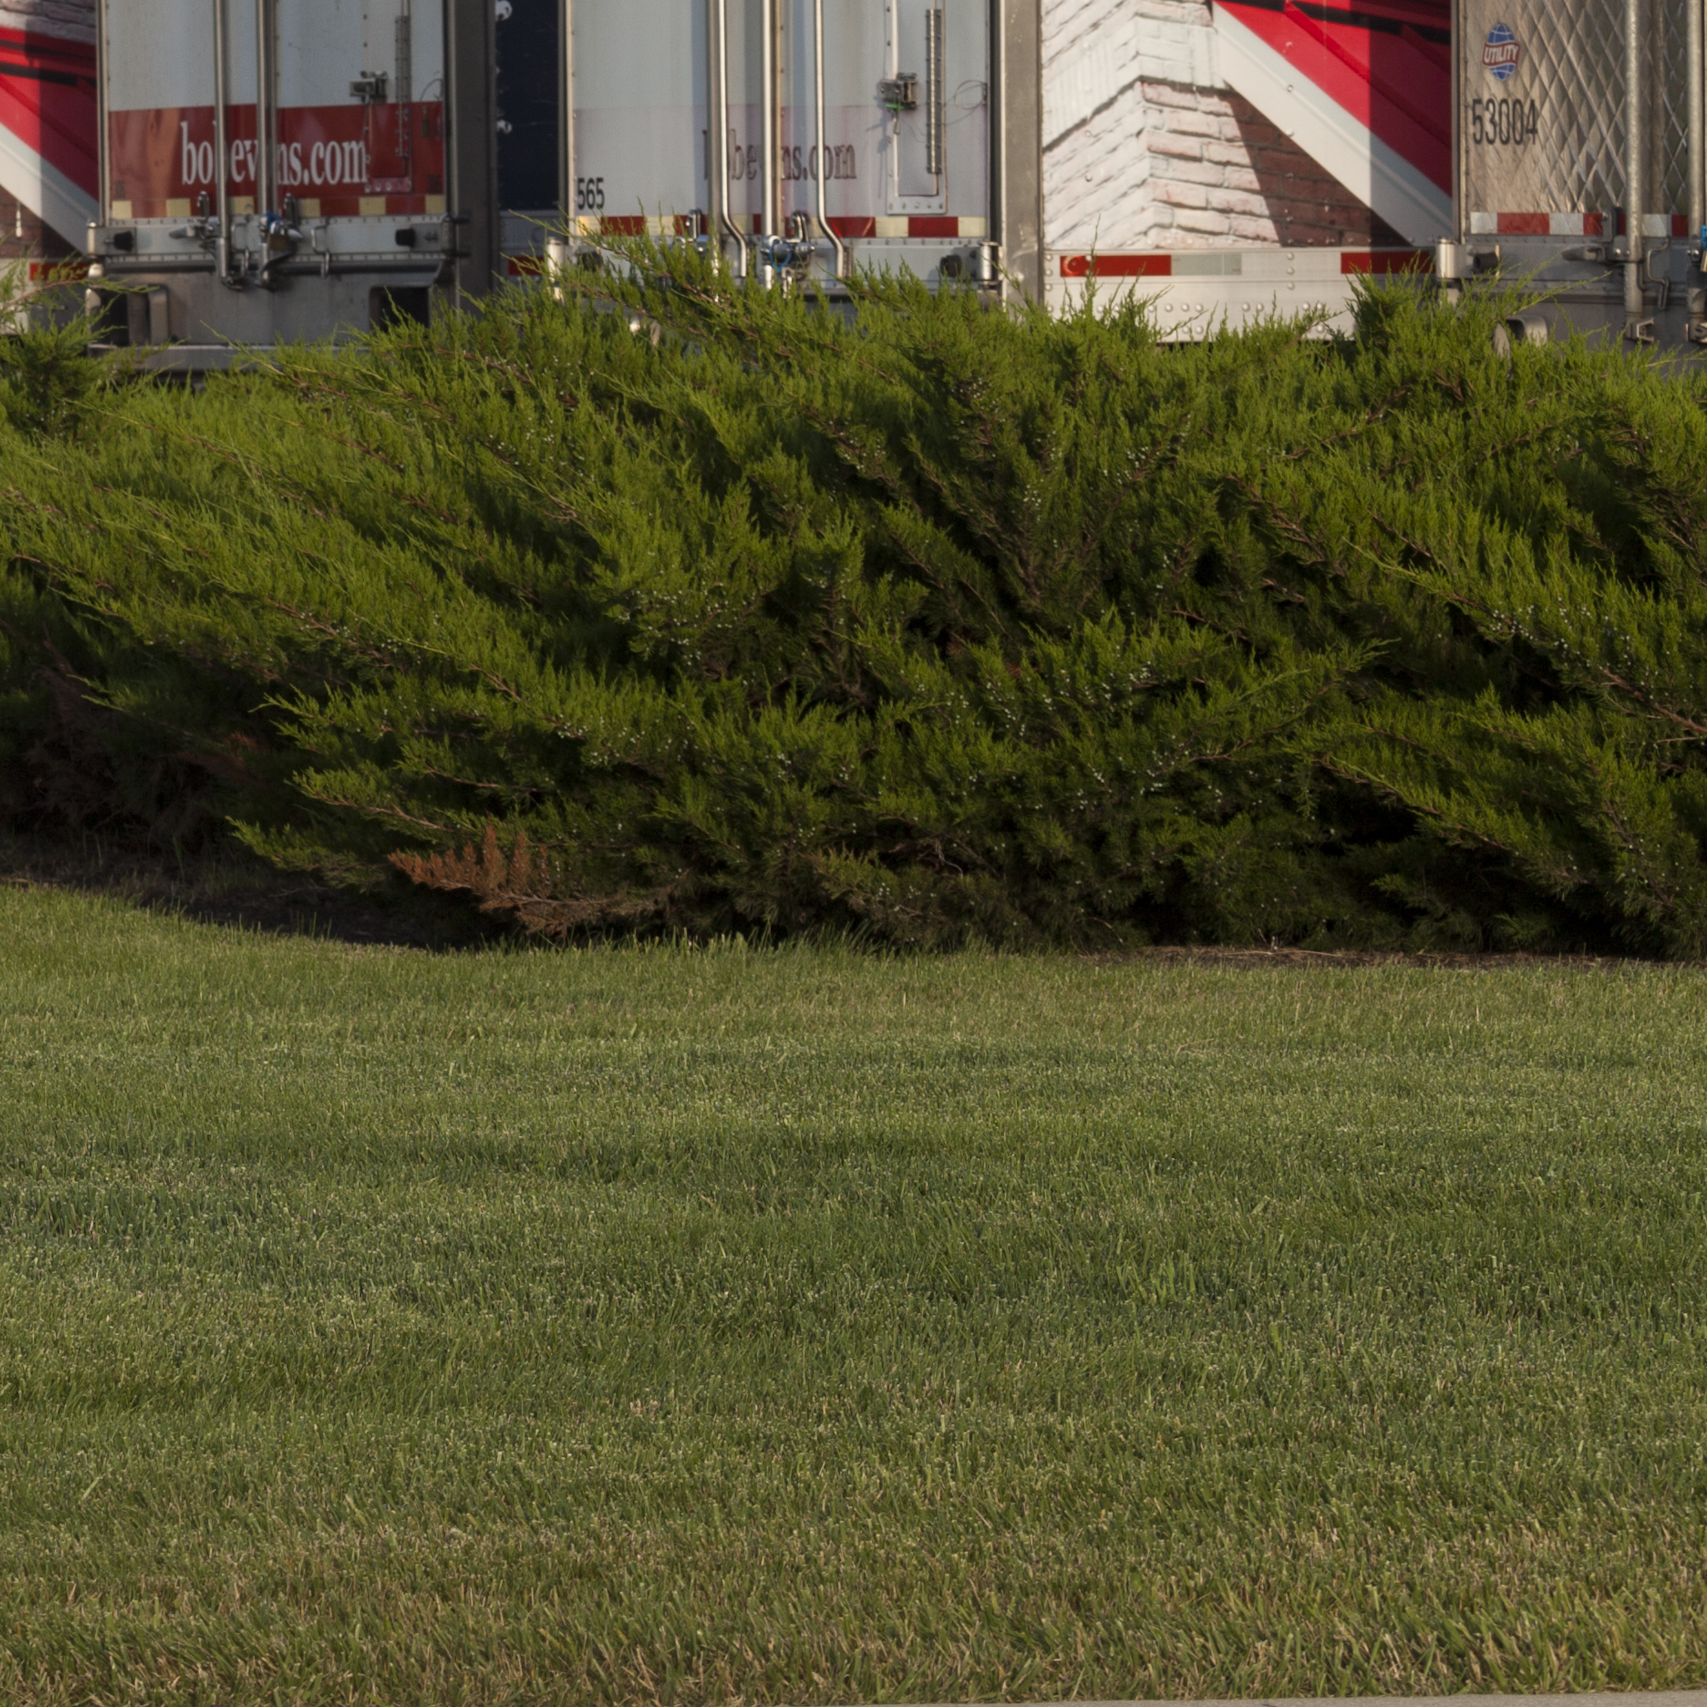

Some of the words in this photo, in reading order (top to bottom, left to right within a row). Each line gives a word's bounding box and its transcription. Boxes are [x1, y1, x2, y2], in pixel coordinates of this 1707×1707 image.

[1483, 44, 1518, 63] UTILITY
[1472, 98, 1538, 145] 53004
[576, 177, 605, 210] 565
